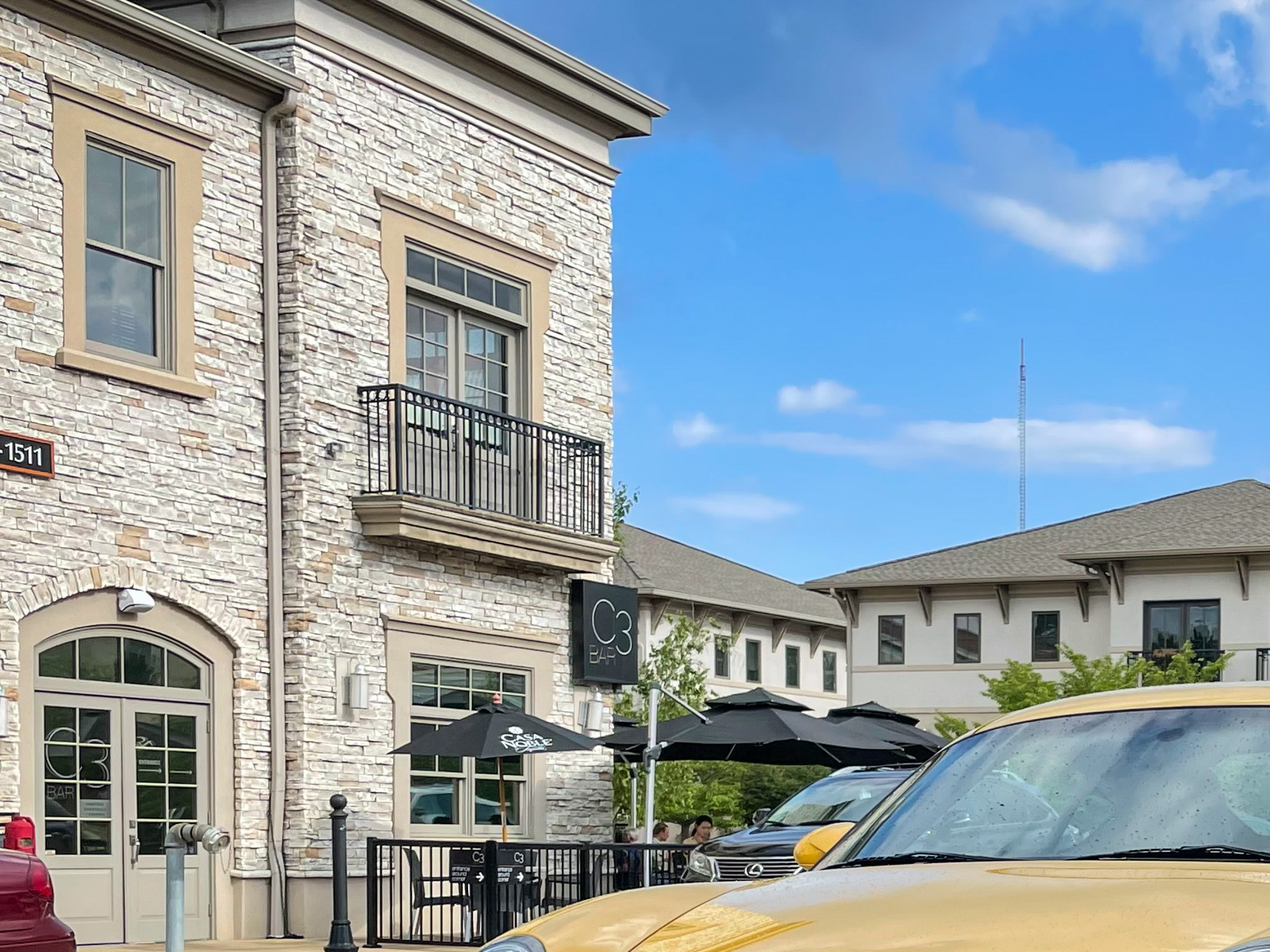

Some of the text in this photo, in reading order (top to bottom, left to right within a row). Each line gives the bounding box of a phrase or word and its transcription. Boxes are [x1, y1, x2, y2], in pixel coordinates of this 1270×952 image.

[591, 598, 633, 656] C3
[589, 644, 616, 666] BAR
[45, 727, 110, 788] C3
[46, 785, 75, 800] BAR
[472, 851, 485, 864] C3
[513, 851, 524, 864] C3
